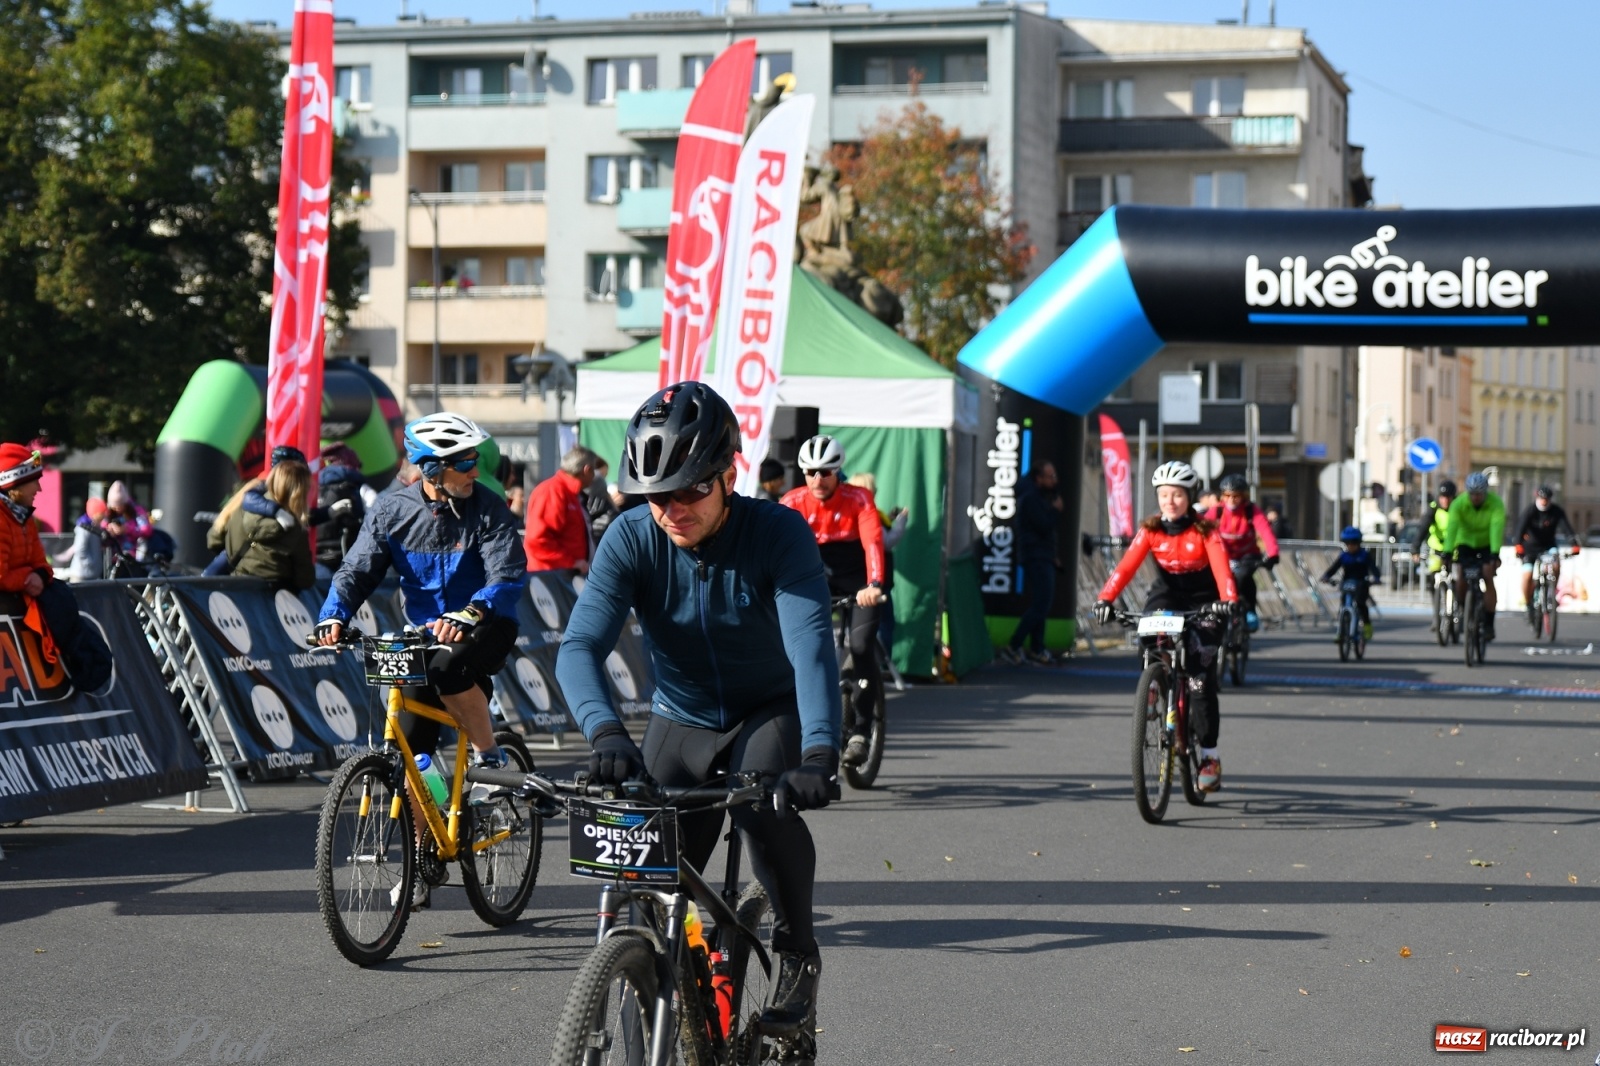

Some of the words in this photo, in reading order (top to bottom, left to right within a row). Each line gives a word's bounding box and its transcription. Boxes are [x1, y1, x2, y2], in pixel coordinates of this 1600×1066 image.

[1245, 254, 1358, 308] bike
[1372, 255, 1549, 308] atelier
[987, 416, 1020, 520] atelier
[981, 525, 1015, 594] bike
[222, 655, 273, 672] KOKOwear
[288, 653, 337, 668] KOKOwear
[371, 651, 414, 661] OPIEKUN
[379, 660, 410, 676] 253
[0, 747, 39, 797] AMY
[32, 732, 157, 789] NAJLEPSZYCH
[265, 751, 314, 769] KOKOwear
[583, 824, 660, 843] OPIEKUN
[595, 840, 651, 867] 257
